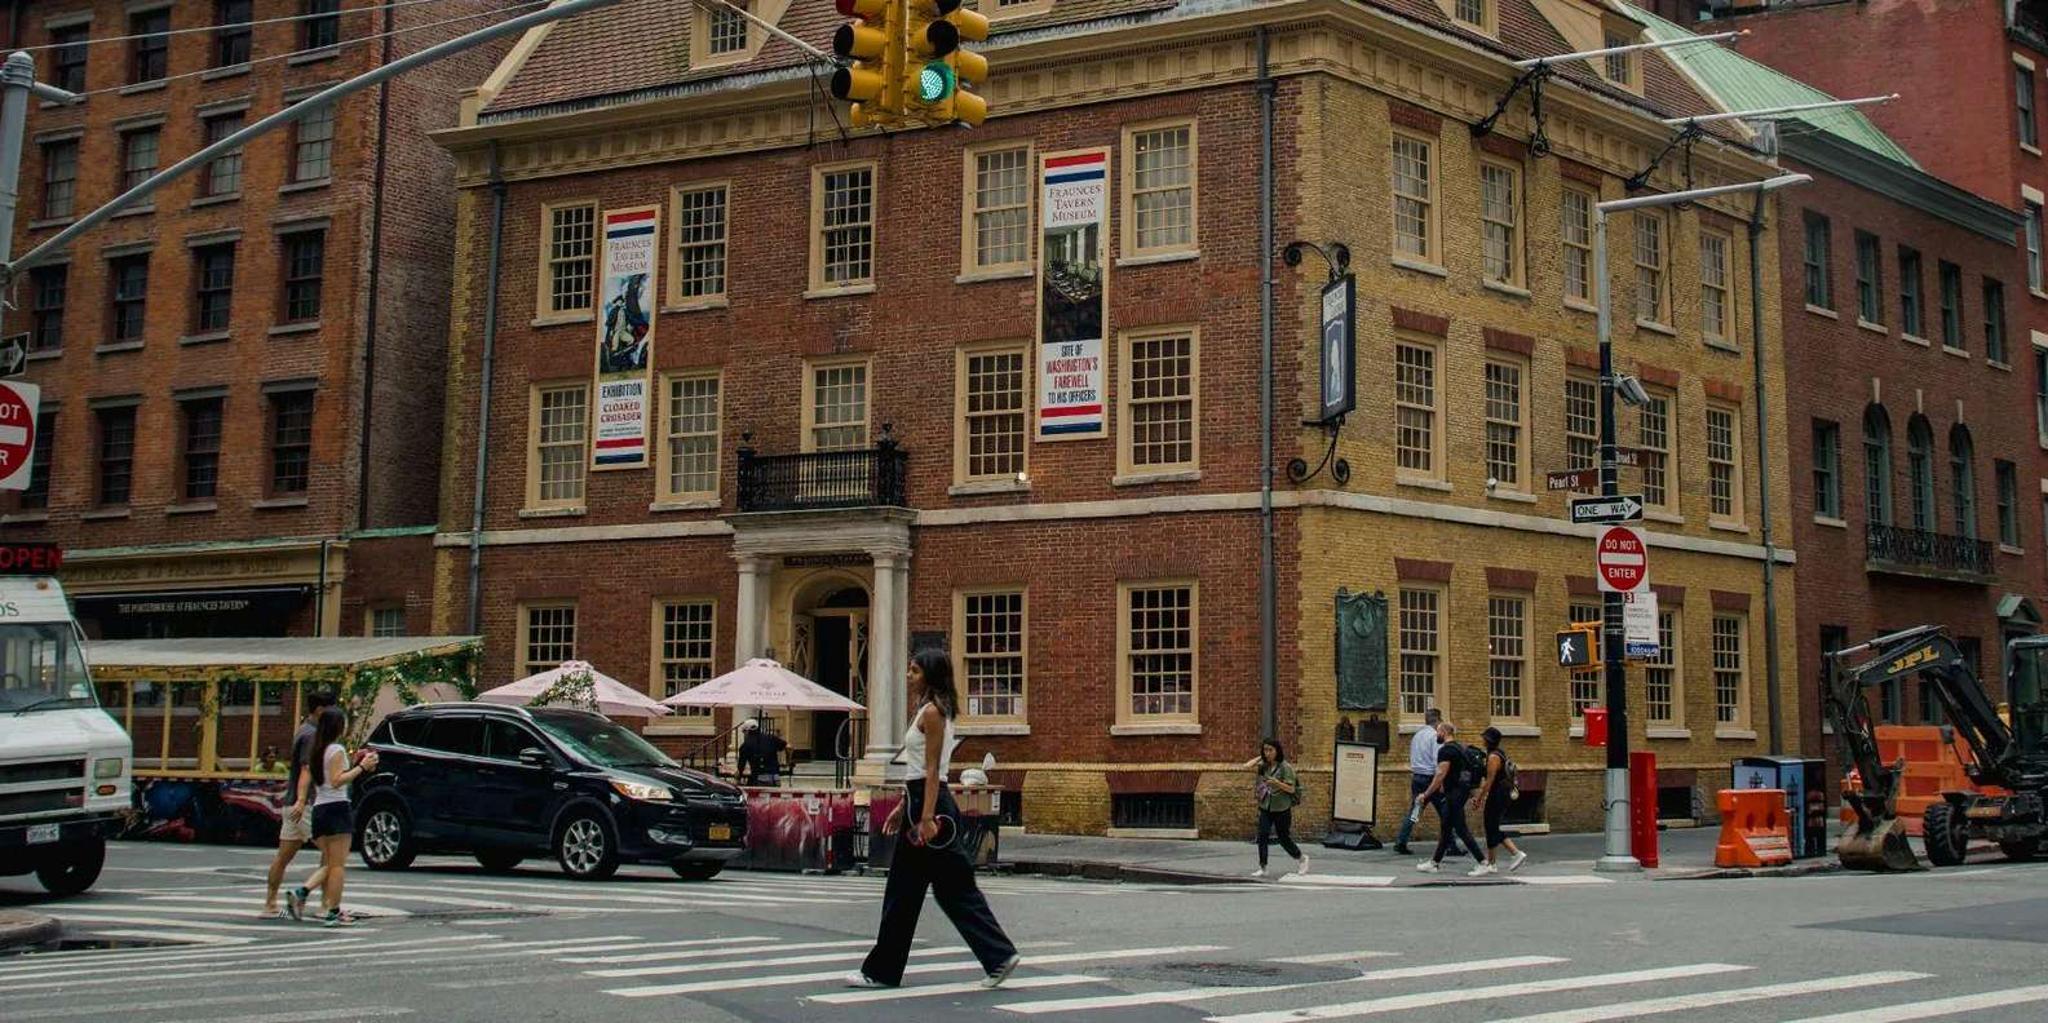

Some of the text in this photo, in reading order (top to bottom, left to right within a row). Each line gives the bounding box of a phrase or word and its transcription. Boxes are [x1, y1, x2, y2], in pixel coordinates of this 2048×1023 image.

[1048, 185, 1102, 198] FRAUNCES
[1056, 198, 1095, 210] TAVERN
[1052, 209, 1097, 222] MUSEUM
[609, 239, 652, 250] FRAUNCES
[614, 251, 646, 262] TAVERN
[611, 261, 648, 272] MUSEUM
[1061, 344, 1083, 357] SITE OF
[1046, 357, 1098, 374] WASHINGTON'S
[1054, 373, 1089, 389] FAREWELL
[602, 382, 643, 398] EXHIBITION
[1048, 390, 1096, 404] TO HIS OFFICERS
[0, 403, 21, 420] OT
[603, 402, 640, 412] CLOAKED
[600, 412, 642, 422] CRUSADER
[1550, 475, 1579, 489] Pearl St
[1577, 503, 1634, 516] ONE WAY
[1605, 540, 1637, 550] DO NOT
[0, 547, 64, 569] OPEN
[1608, 568, 1637, 579] ENTER
[1887, 645, 1940, 673] JPL
